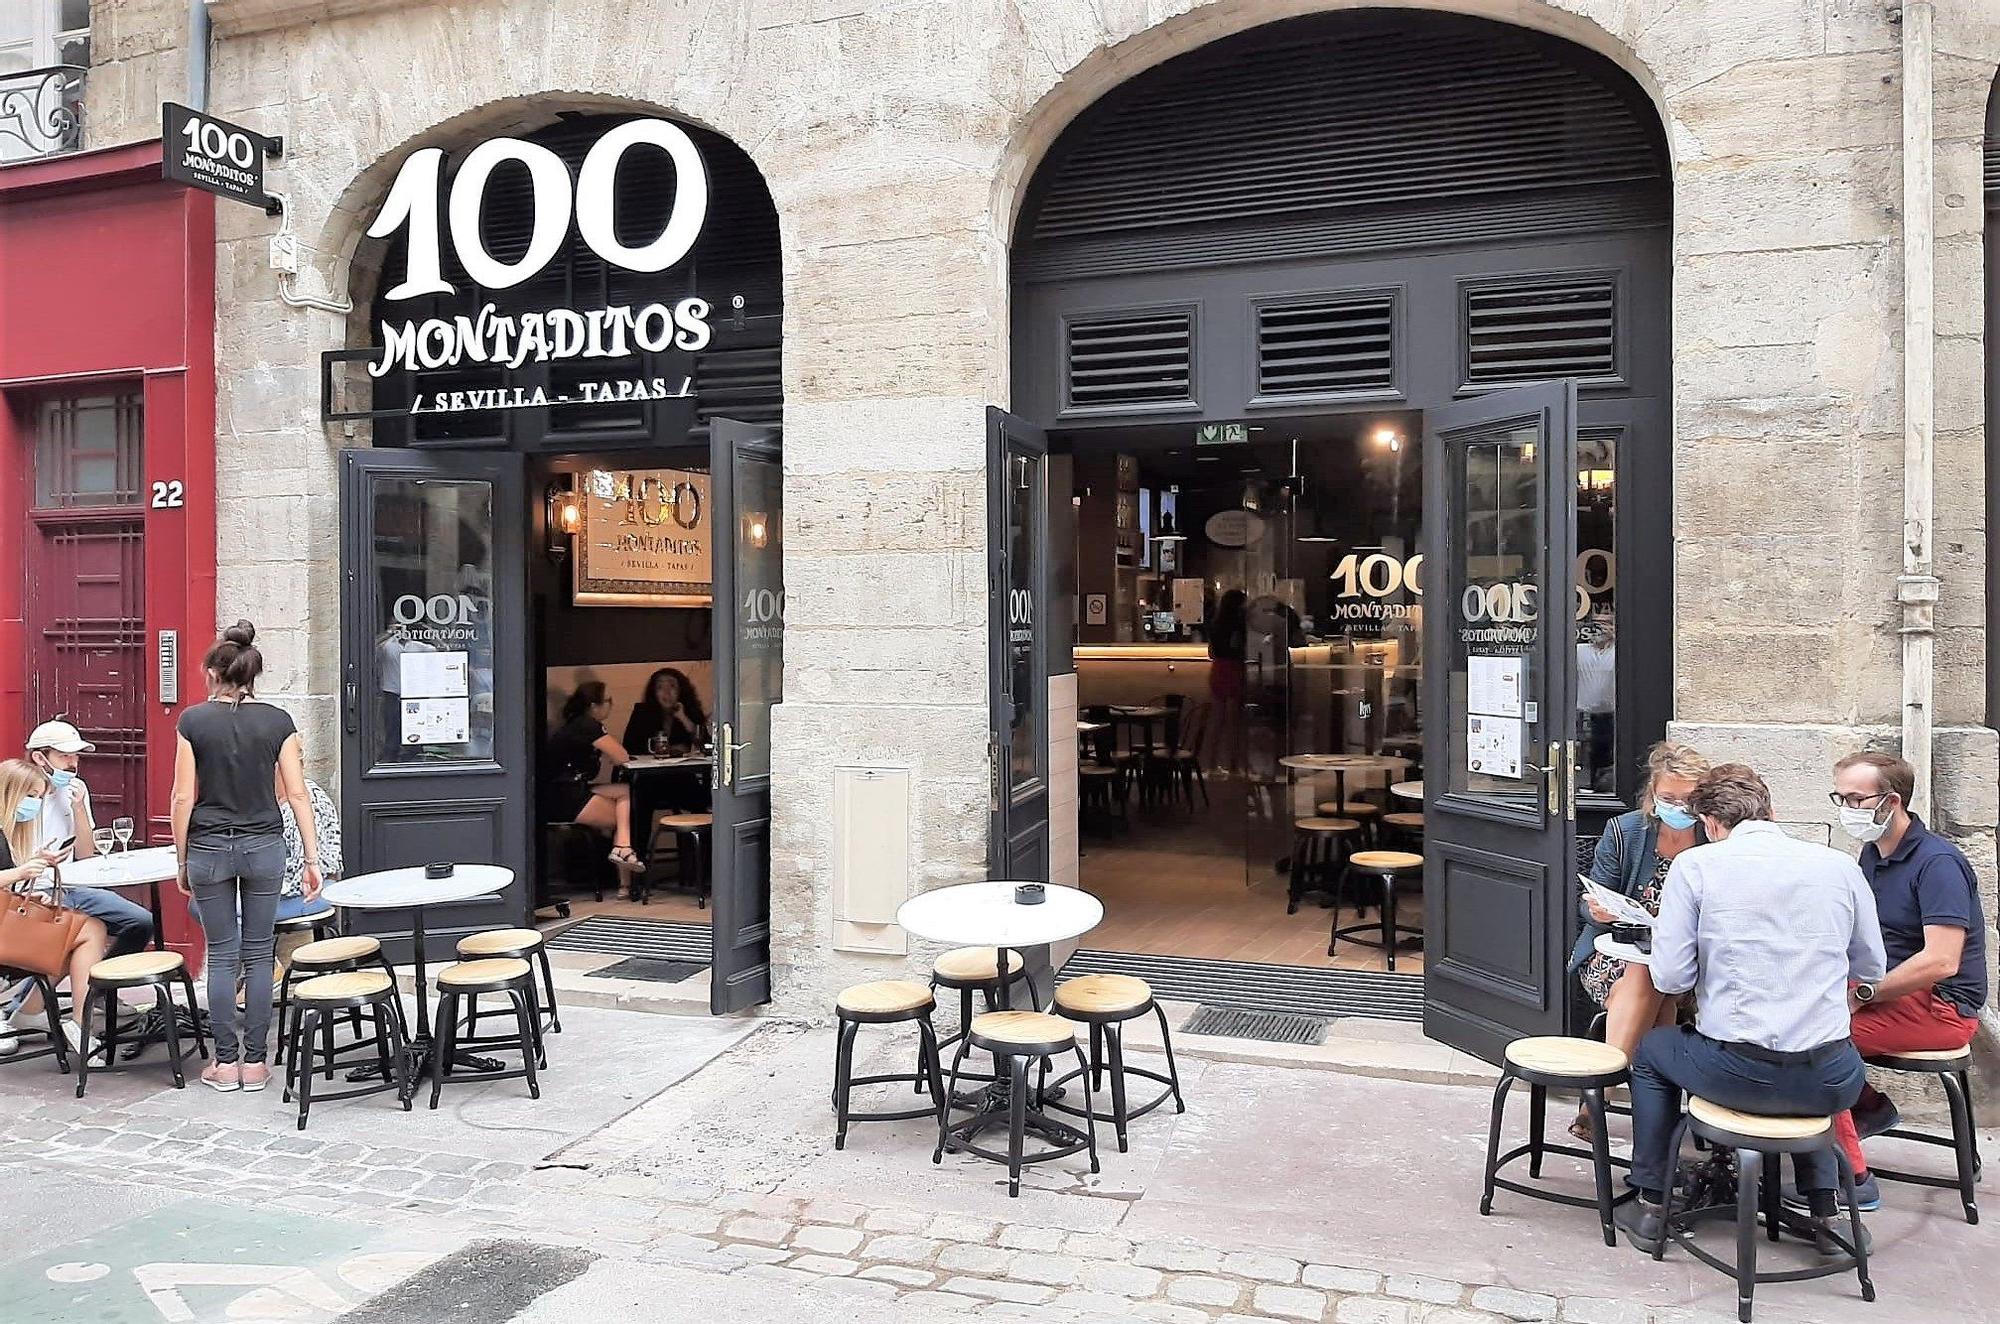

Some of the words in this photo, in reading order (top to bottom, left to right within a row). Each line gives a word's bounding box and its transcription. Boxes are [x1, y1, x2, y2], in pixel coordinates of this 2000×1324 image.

[182, 117, 254, 168] 100
[182, 152, 254, 186] MONTADITOS
[367, 118, 708, 300] 100
[368, 297, 711, 378] MONTADITOS
[435, 385, 549, 412] SEVILLA
[579, 378, 667, 402] TAPAS
[151, 480, 183, 508] 22
[614, 474, 701, 530] 100
